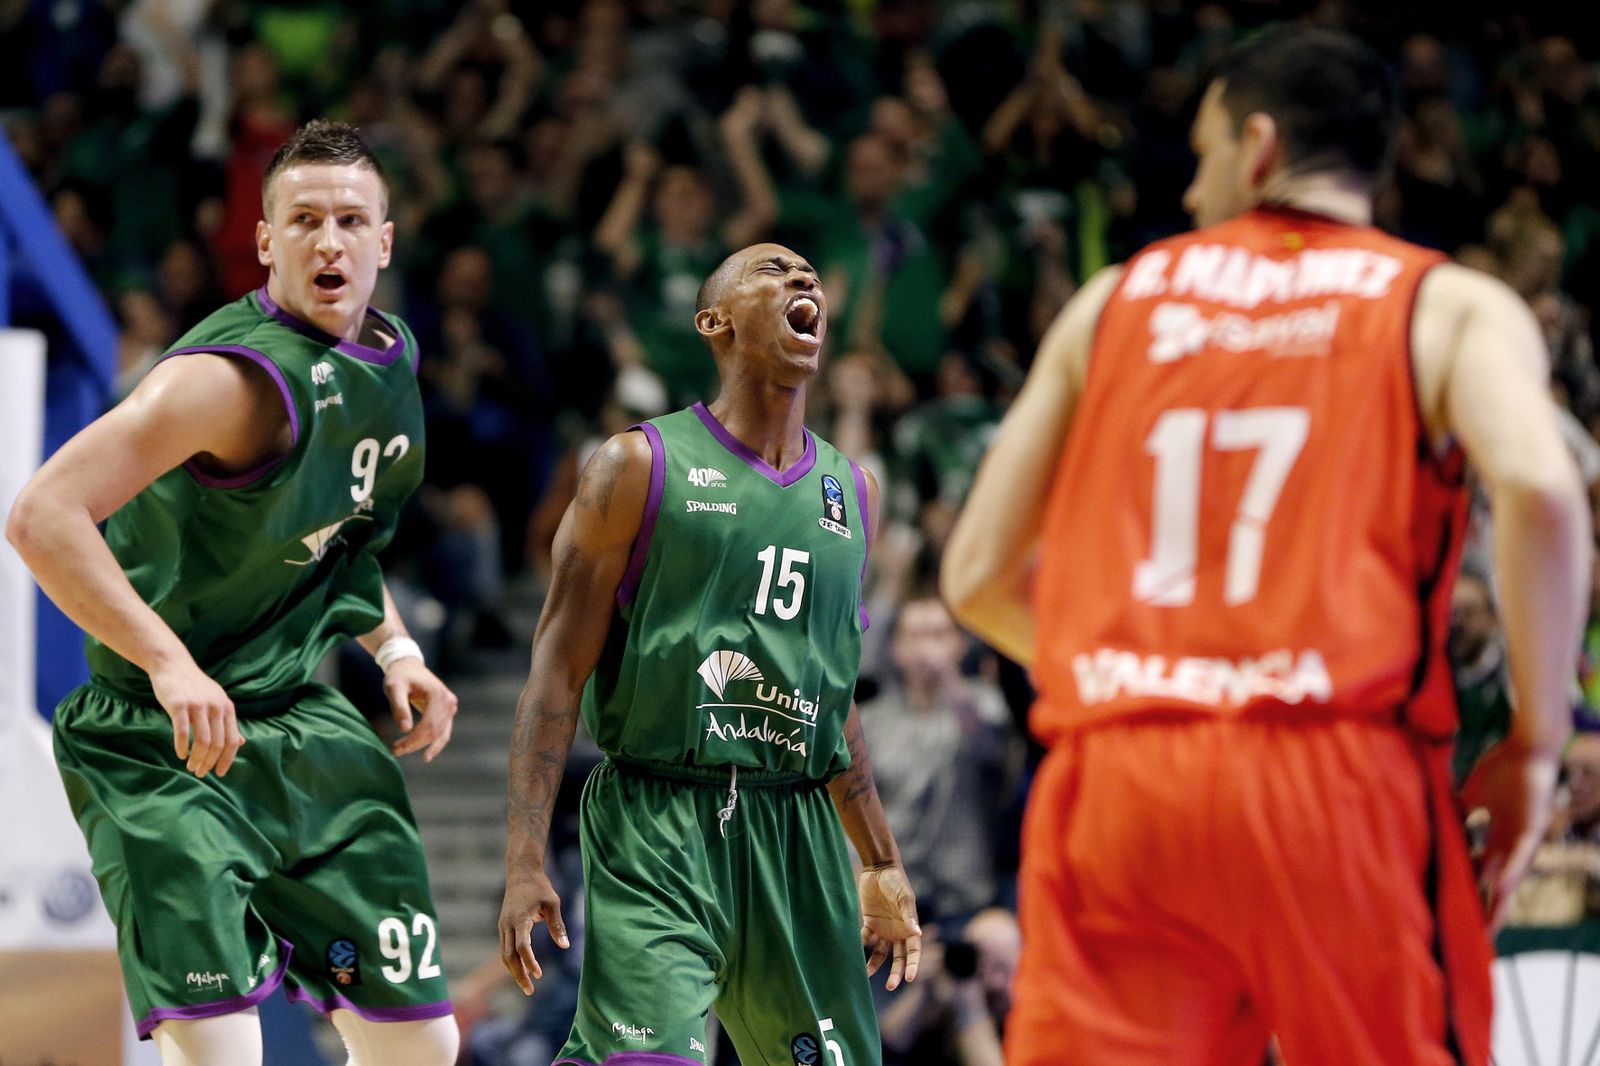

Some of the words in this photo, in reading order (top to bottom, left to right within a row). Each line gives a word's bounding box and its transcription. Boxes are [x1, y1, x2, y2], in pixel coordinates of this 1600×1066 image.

[686, 500, 737, 515] SPALDING
[687, 467, 709, 487] 40
[1130, 406, 1312, 608] 17
[754, 544, 810, 621] 15
[377, 913, 441, 984] 92
